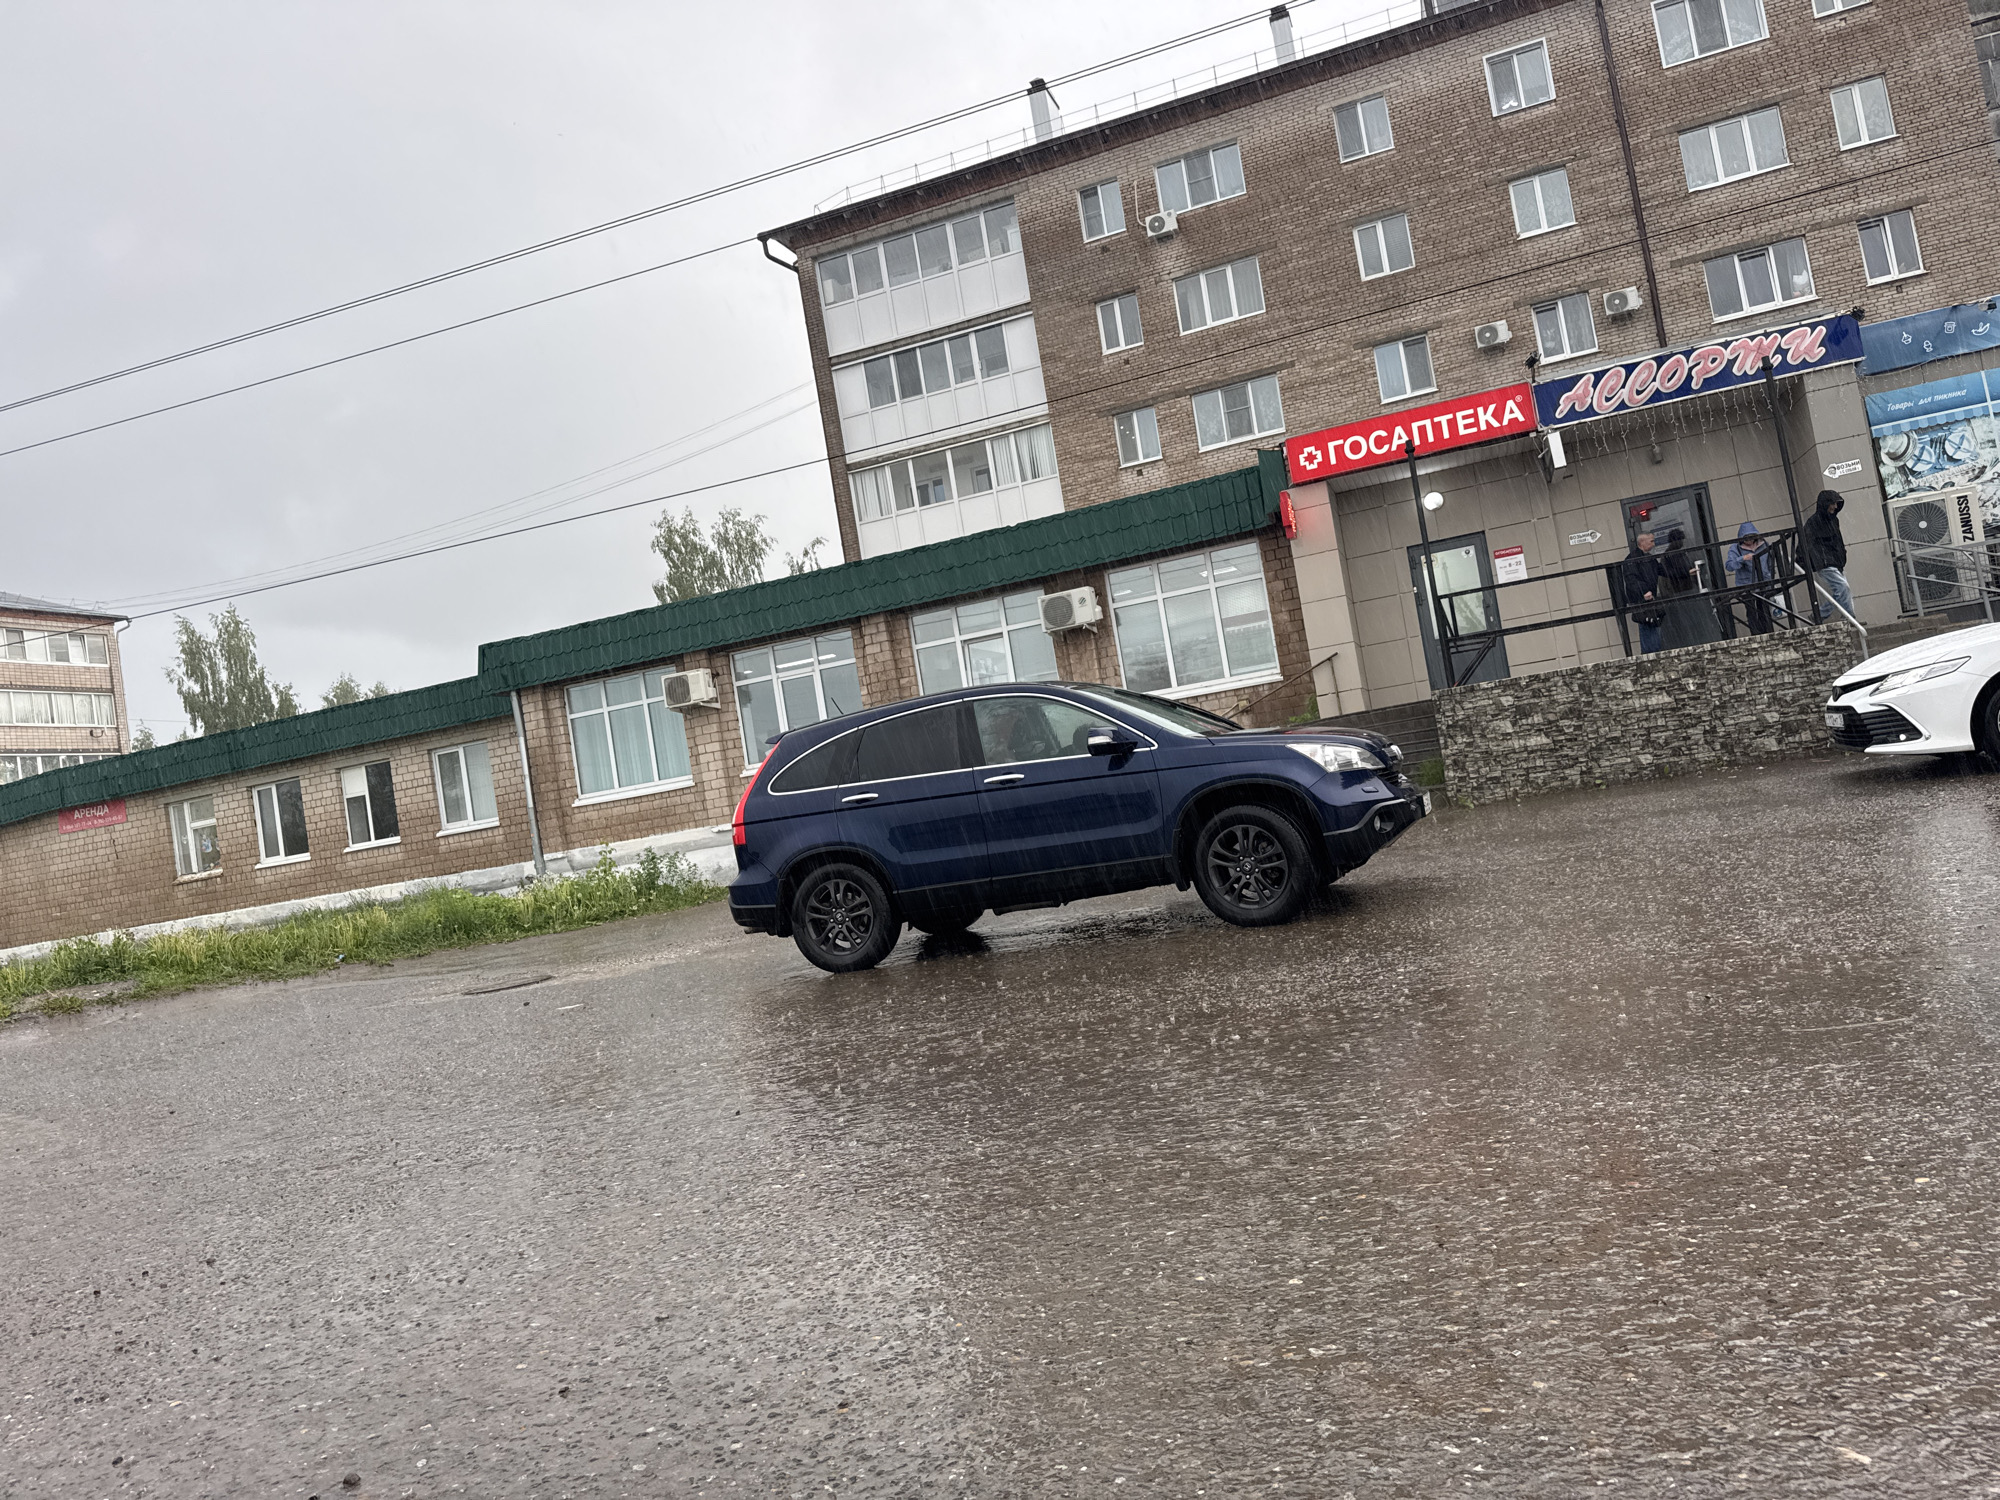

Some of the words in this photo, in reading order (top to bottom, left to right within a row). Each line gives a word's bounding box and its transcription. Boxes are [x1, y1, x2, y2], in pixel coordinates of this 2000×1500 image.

[1555, 325, 1827, 419] АССОРТИ
[1887, 400, 1915, 412] Товары
[1918, 397, 1932, 406] для
[1933, 389, 1968, 402] пикника
[1327, 399, 1526, 466] ГОСАПТЕКА
[1956, 494, 1976, 543] ZANUSSI
[74, 804, 109, 820] АРЕНДА
